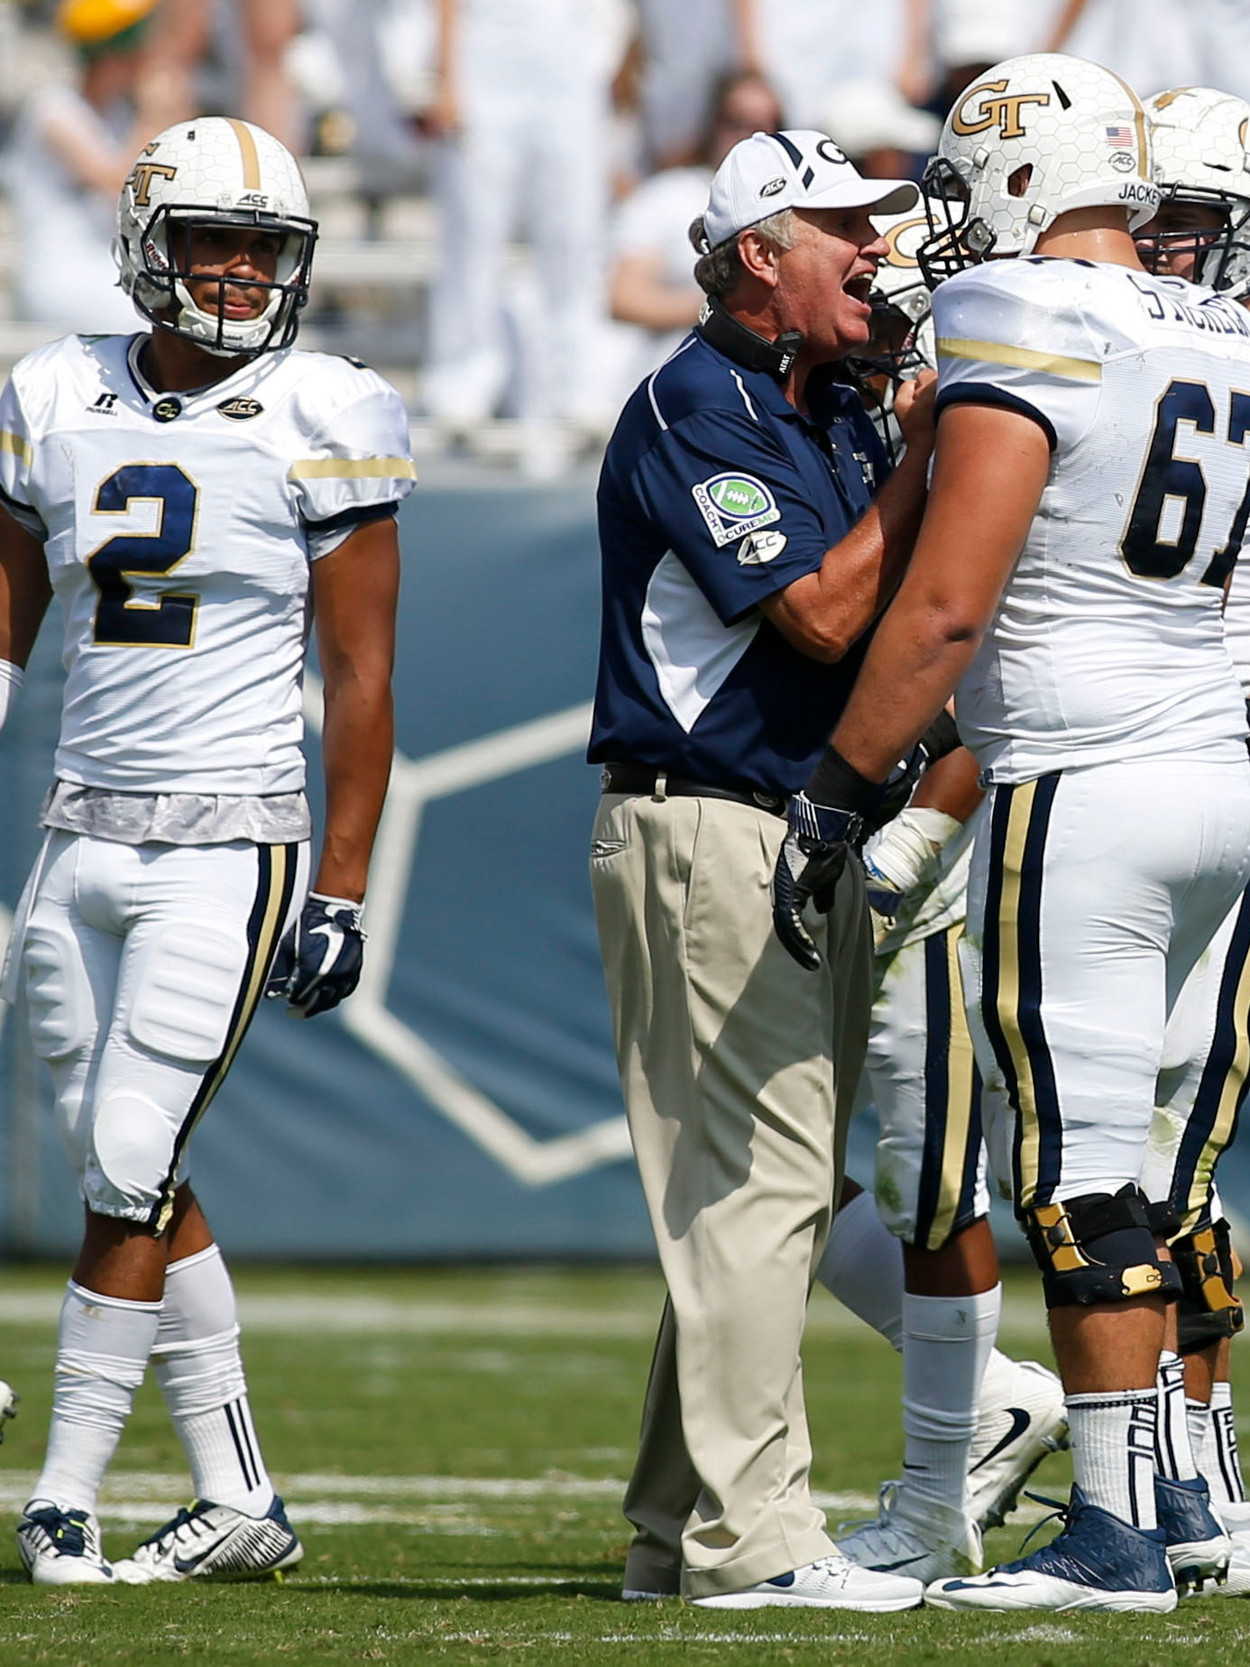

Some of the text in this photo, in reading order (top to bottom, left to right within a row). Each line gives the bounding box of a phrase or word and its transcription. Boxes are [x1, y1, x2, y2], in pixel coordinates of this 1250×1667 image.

[951, 79, 1050, 139] GT
[236, 193, 269, 208] ACC
[222, 401, 259, 415] ACC
[85, 460, 201, 649] 2
